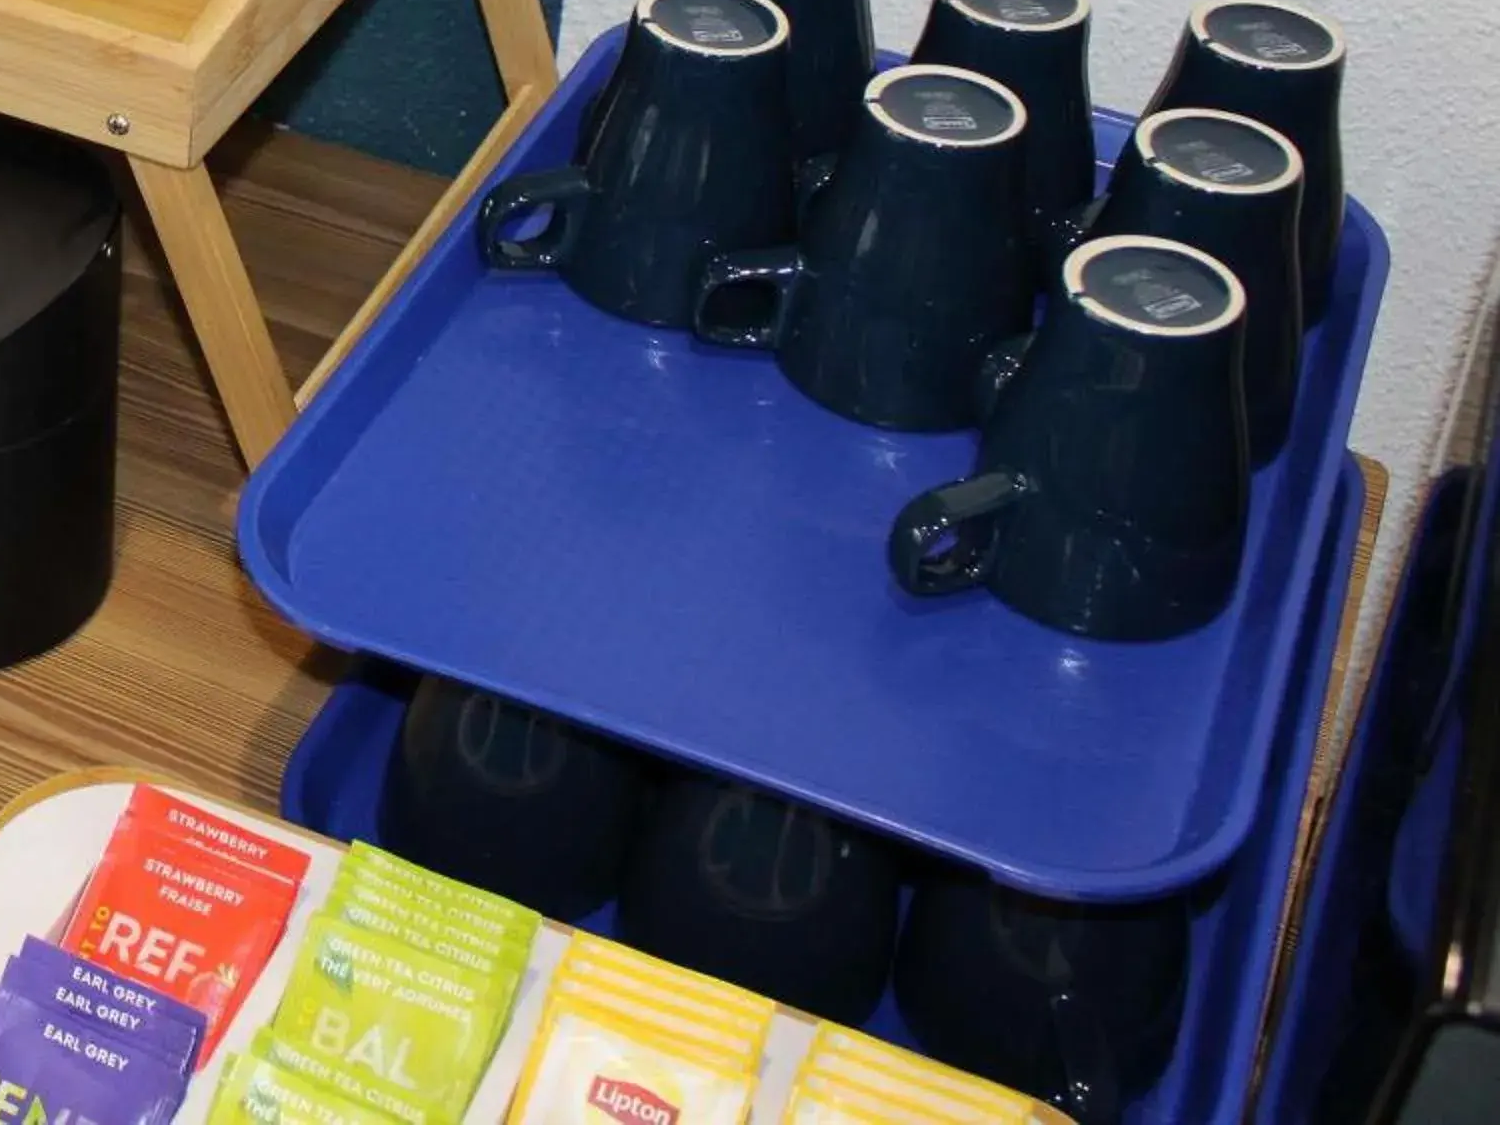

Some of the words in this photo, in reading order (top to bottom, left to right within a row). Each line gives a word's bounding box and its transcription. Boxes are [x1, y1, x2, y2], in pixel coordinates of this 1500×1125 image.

[167, 808, 269, 860] STRAWBERRY
[143, 858, 245, 907] STRAWBERRY
[158, 885, 213, 916] FRAISE
[98, 910, 206, 984] REF
[55, 986, 93, 1015] EARL
[95, 1004, 142, 1031] GREY
[72, 965, 110, 995] EARL
[112, 985, 158, 1013] GREY
[43, 1023, 81, 1053] EARL
[84, 1043, 130, 1072] GREY
[596, 1081, 671, 1125] Lipton
